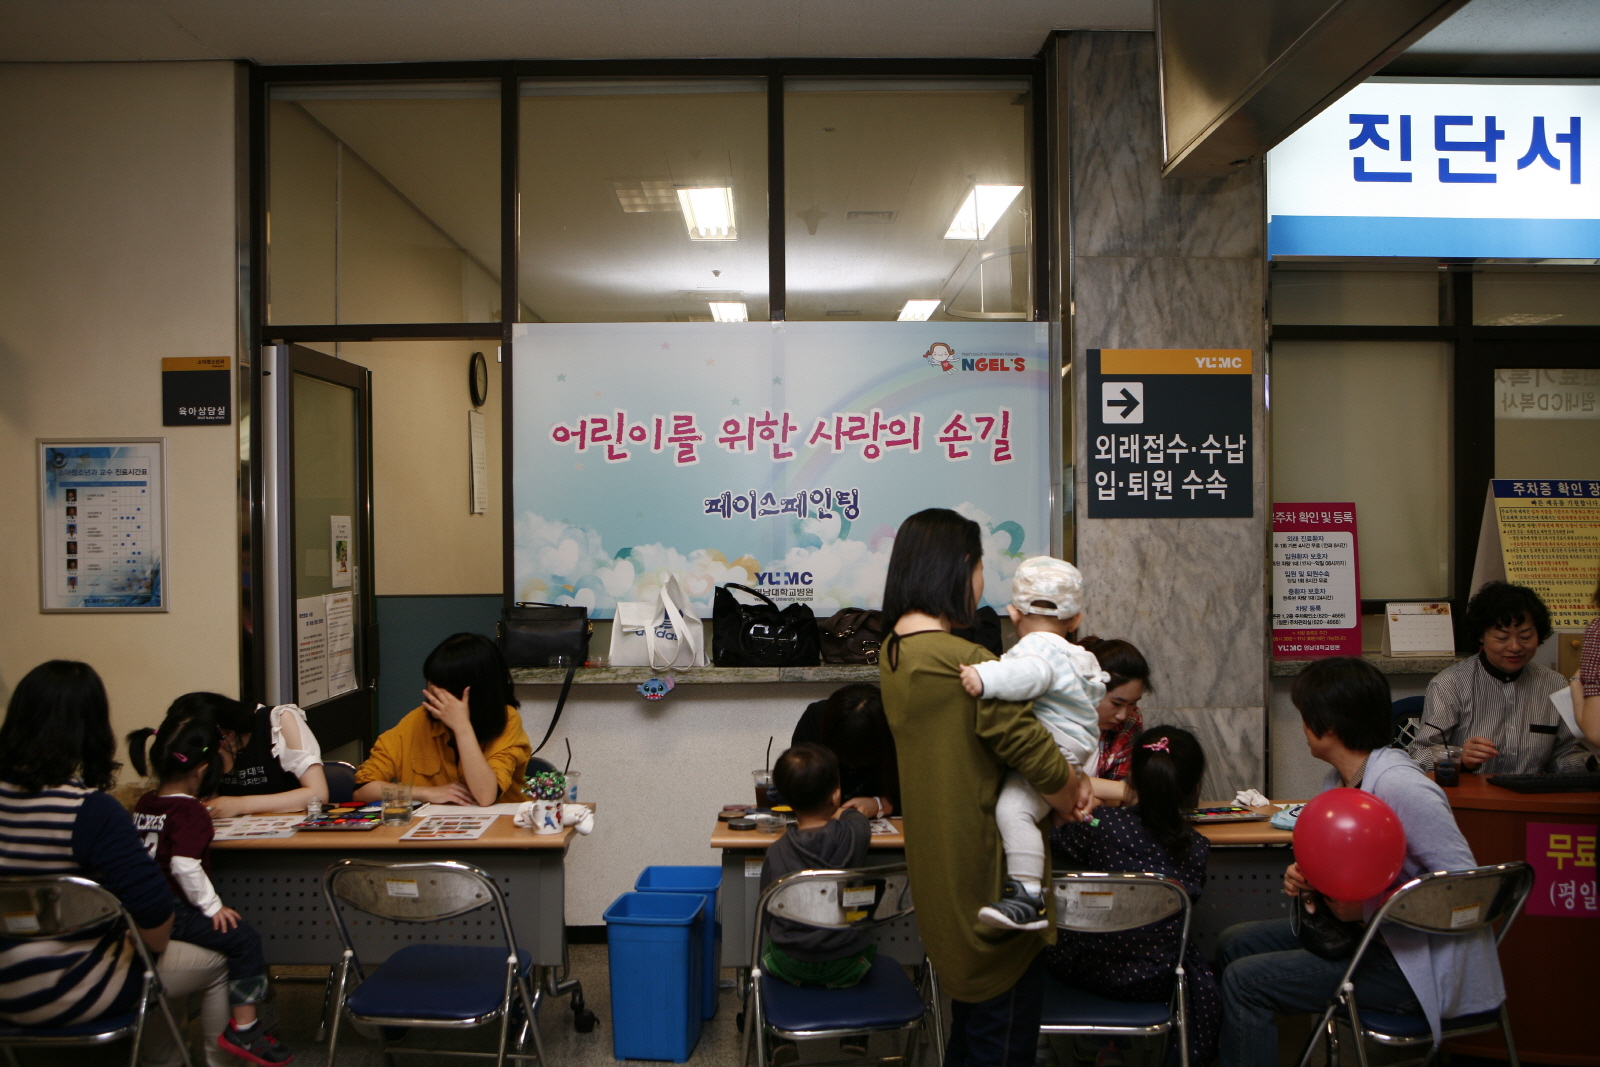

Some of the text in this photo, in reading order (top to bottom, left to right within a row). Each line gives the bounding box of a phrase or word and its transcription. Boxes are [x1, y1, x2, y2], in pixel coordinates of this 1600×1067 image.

[1349, 114, 1581, 185] 진단서
[962, 357, 1025, 372] NGEL'S
[179, 406, 225, 416] 육아상담실
[551, 410, 1012, 463] 어린이를 위한 사랑의 손길
[99, 468, 113, 476] 교수
[115, 468, 148, 476] 진료시간표
[1181, 470, 1228, 500] 수속
[1513, 482, 1552, 497] 주차증
[1558, 482, 1583, 497] 확인
[703, 487, 860, 520] 페이스페인팅
[1272, 511, 1354, 524] 주차 확인 및 등록
